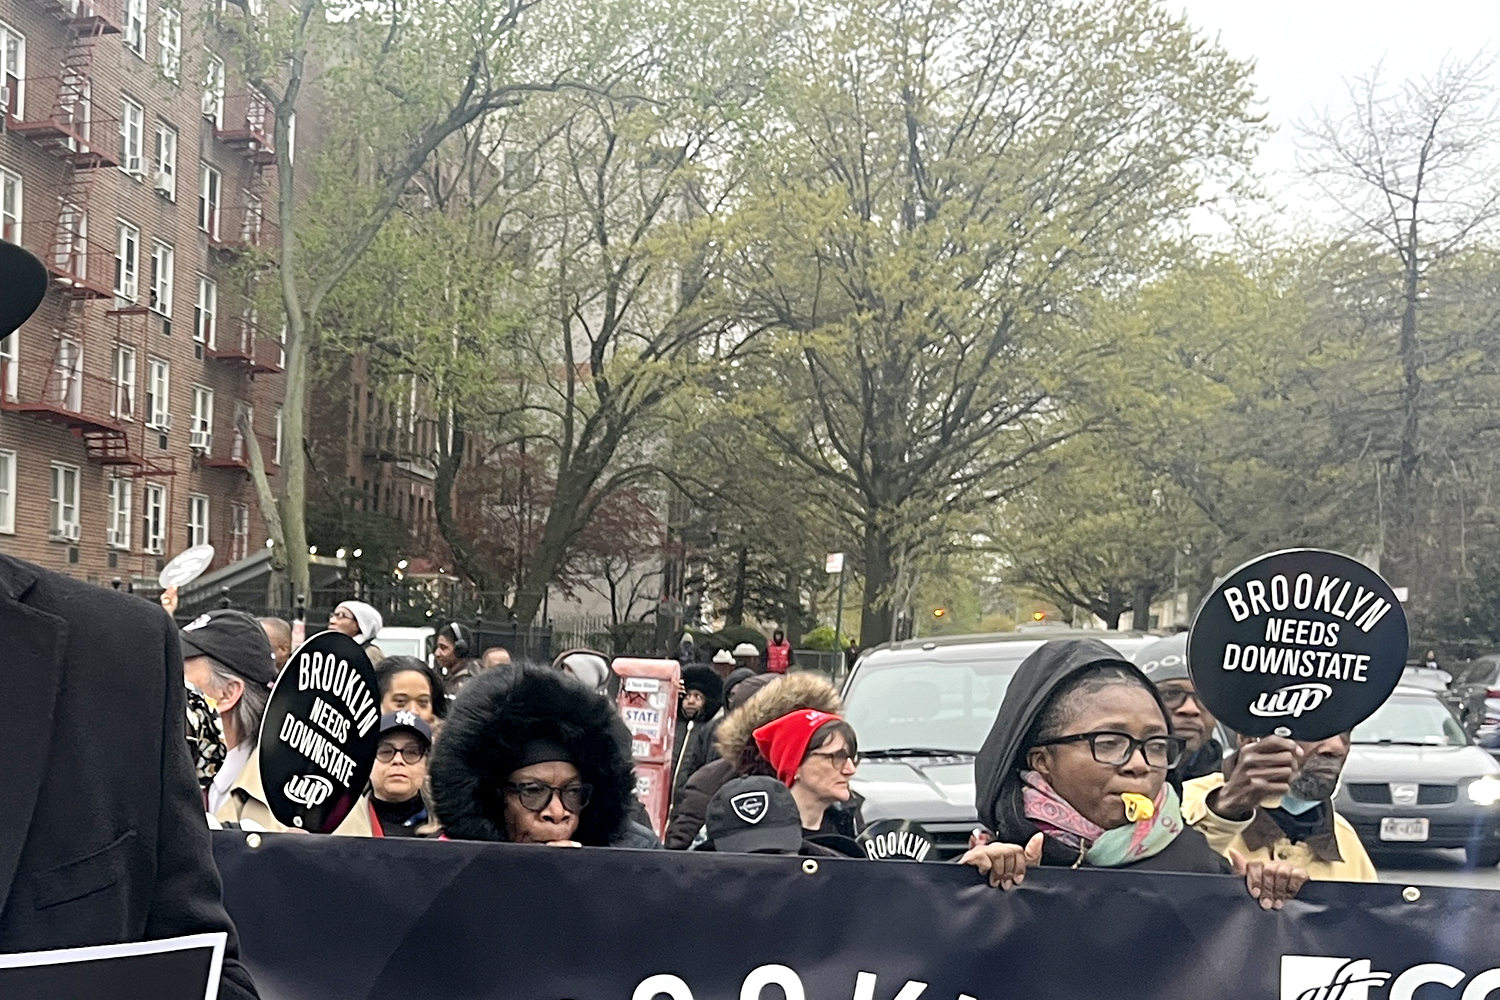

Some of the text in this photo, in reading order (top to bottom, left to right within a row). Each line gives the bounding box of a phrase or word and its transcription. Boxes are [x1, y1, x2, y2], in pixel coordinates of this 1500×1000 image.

[1223, 573, 1392, 633] BROOKLYN
[1265, 618, 1340, 647] NEEDS
[1222, 643, 1371, 682] DOWNSTATE
[299, 651, 379, 738] BROOKLYN
[626, 709, 660, 722] STATE
[309, 697, 350, 744] NEEDS
[279, 713, 357, 788] DOWNSTATE
[865, 831, 931, 862] ROOKLYN
